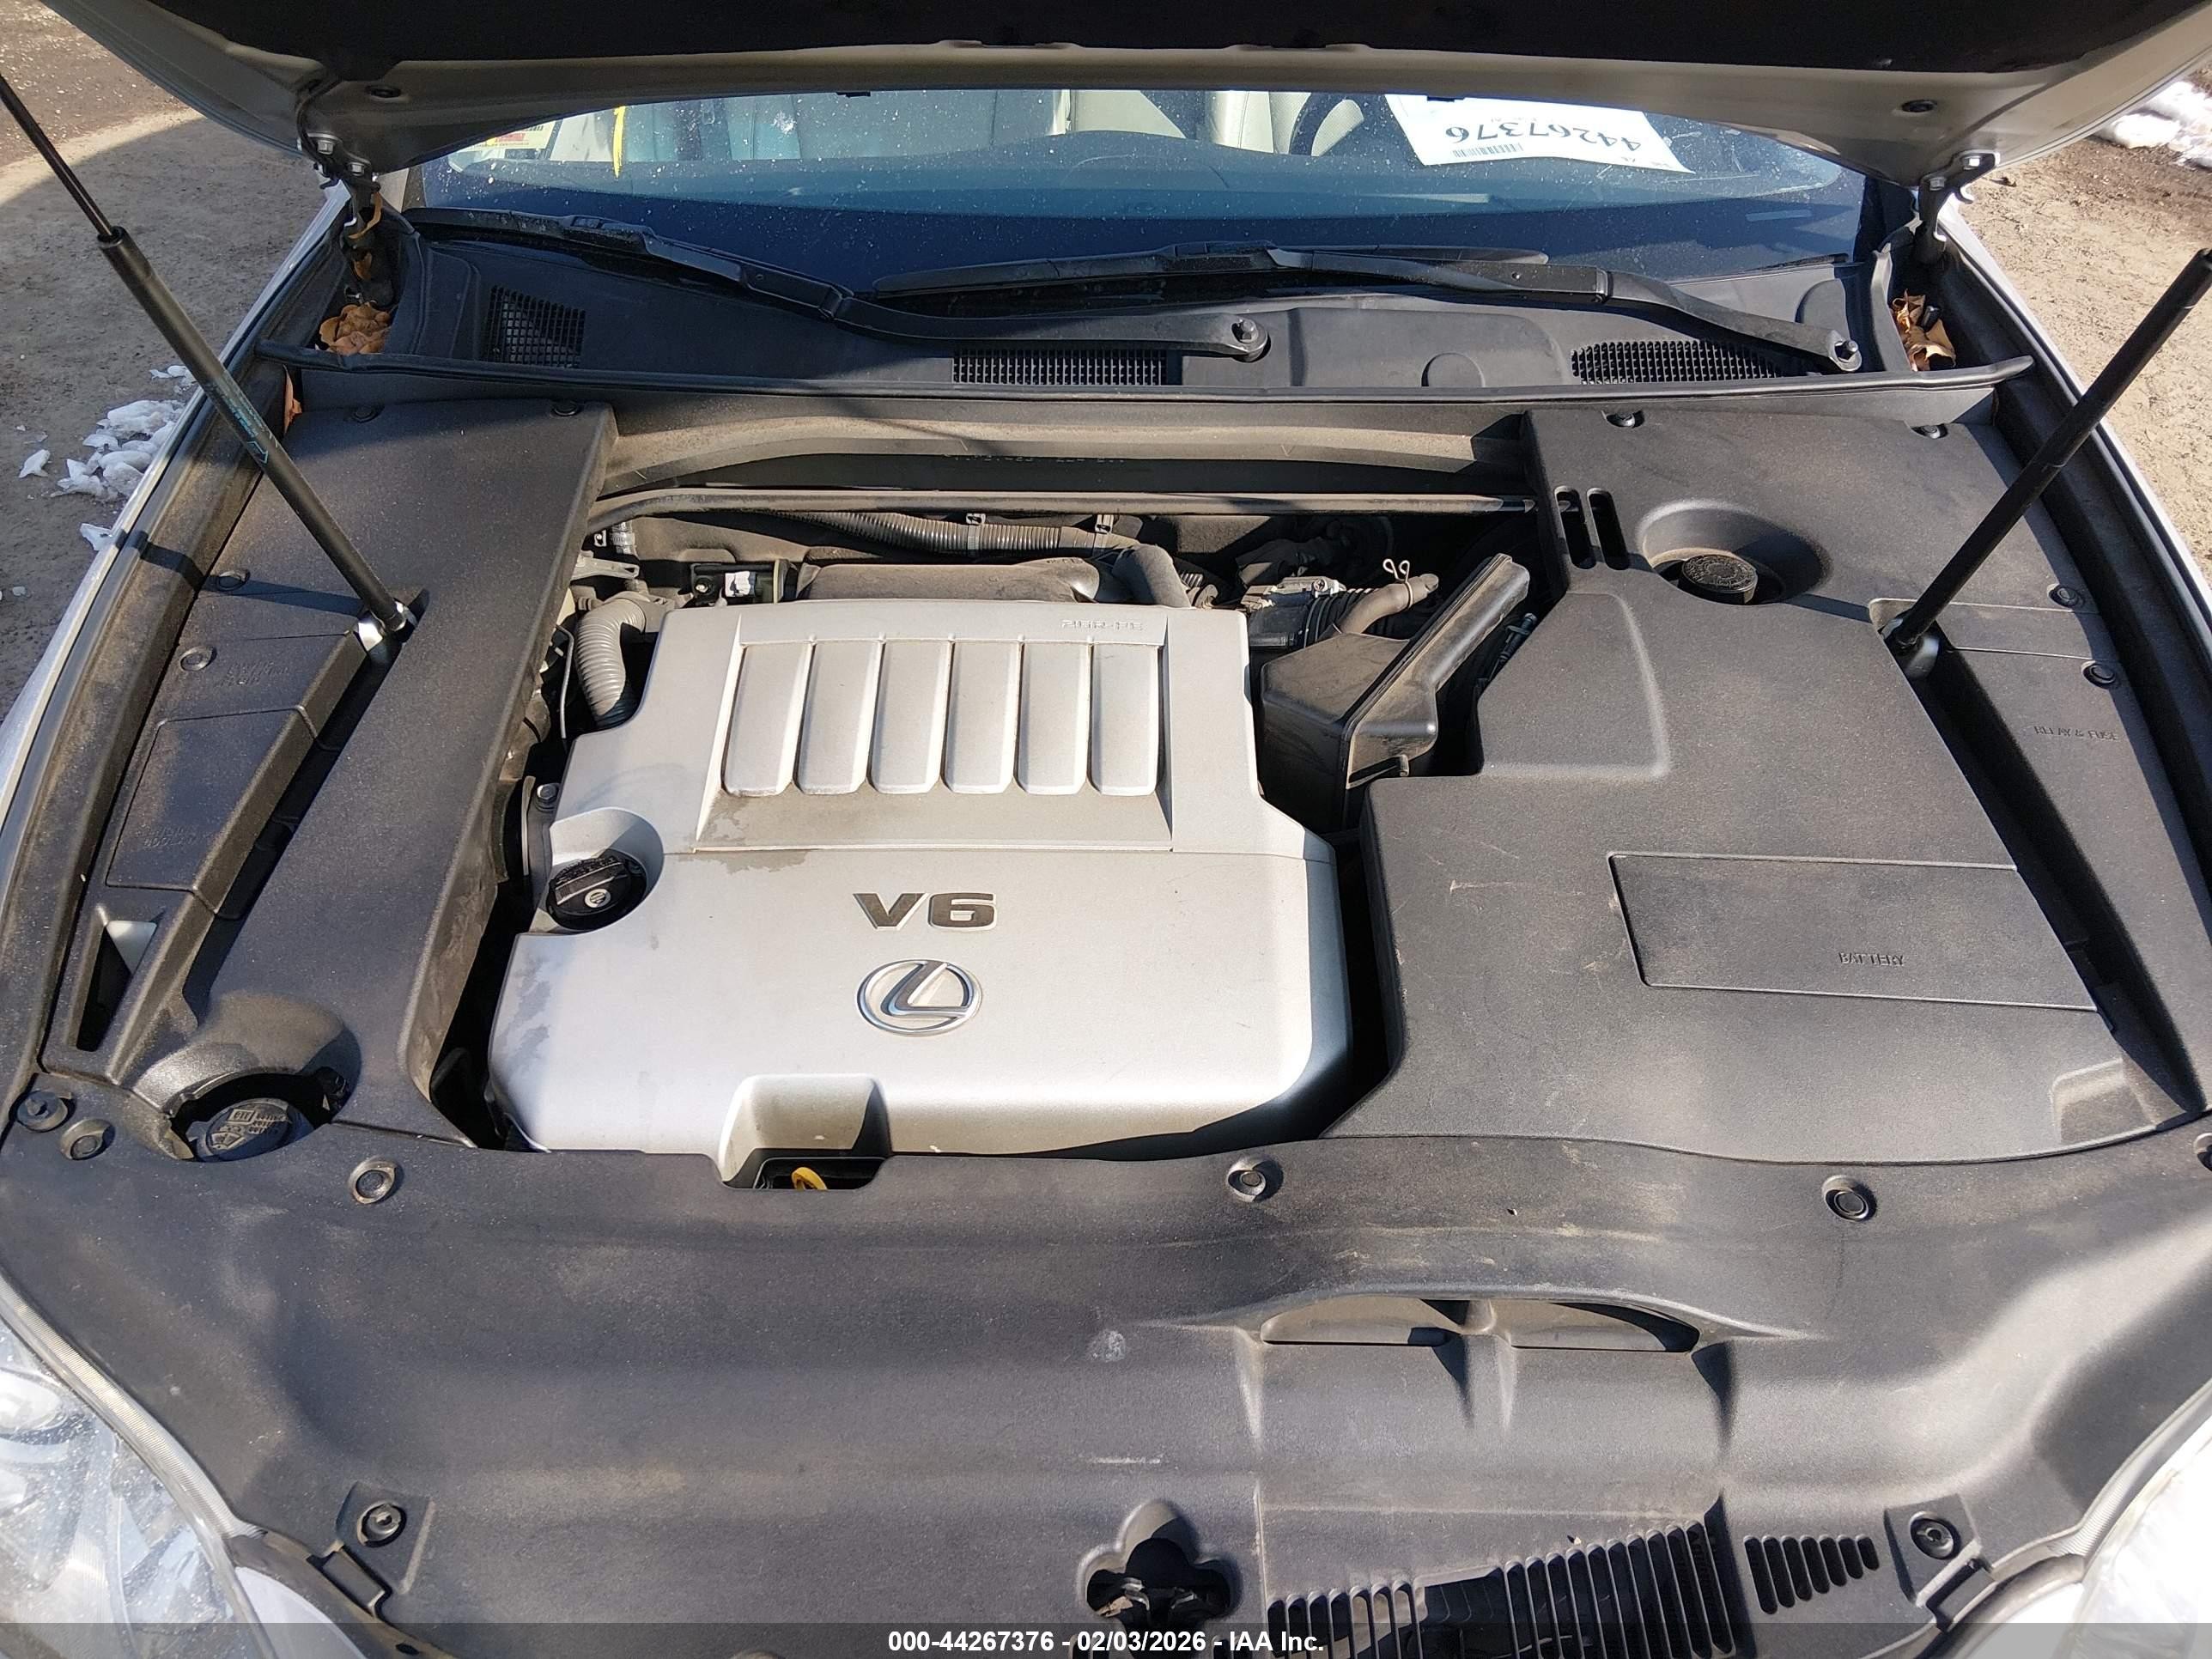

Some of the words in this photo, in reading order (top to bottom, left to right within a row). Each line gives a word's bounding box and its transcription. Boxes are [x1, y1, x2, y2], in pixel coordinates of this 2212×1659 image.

[1445, 121, 1642, 153] 44267376
[2033, 726, 2071, 738] RELAY
[2087, 730, 2121, 741] FUSE
[852, 892, 998, 933] V6
[1838, 952, 1904, 967] BATTERY
